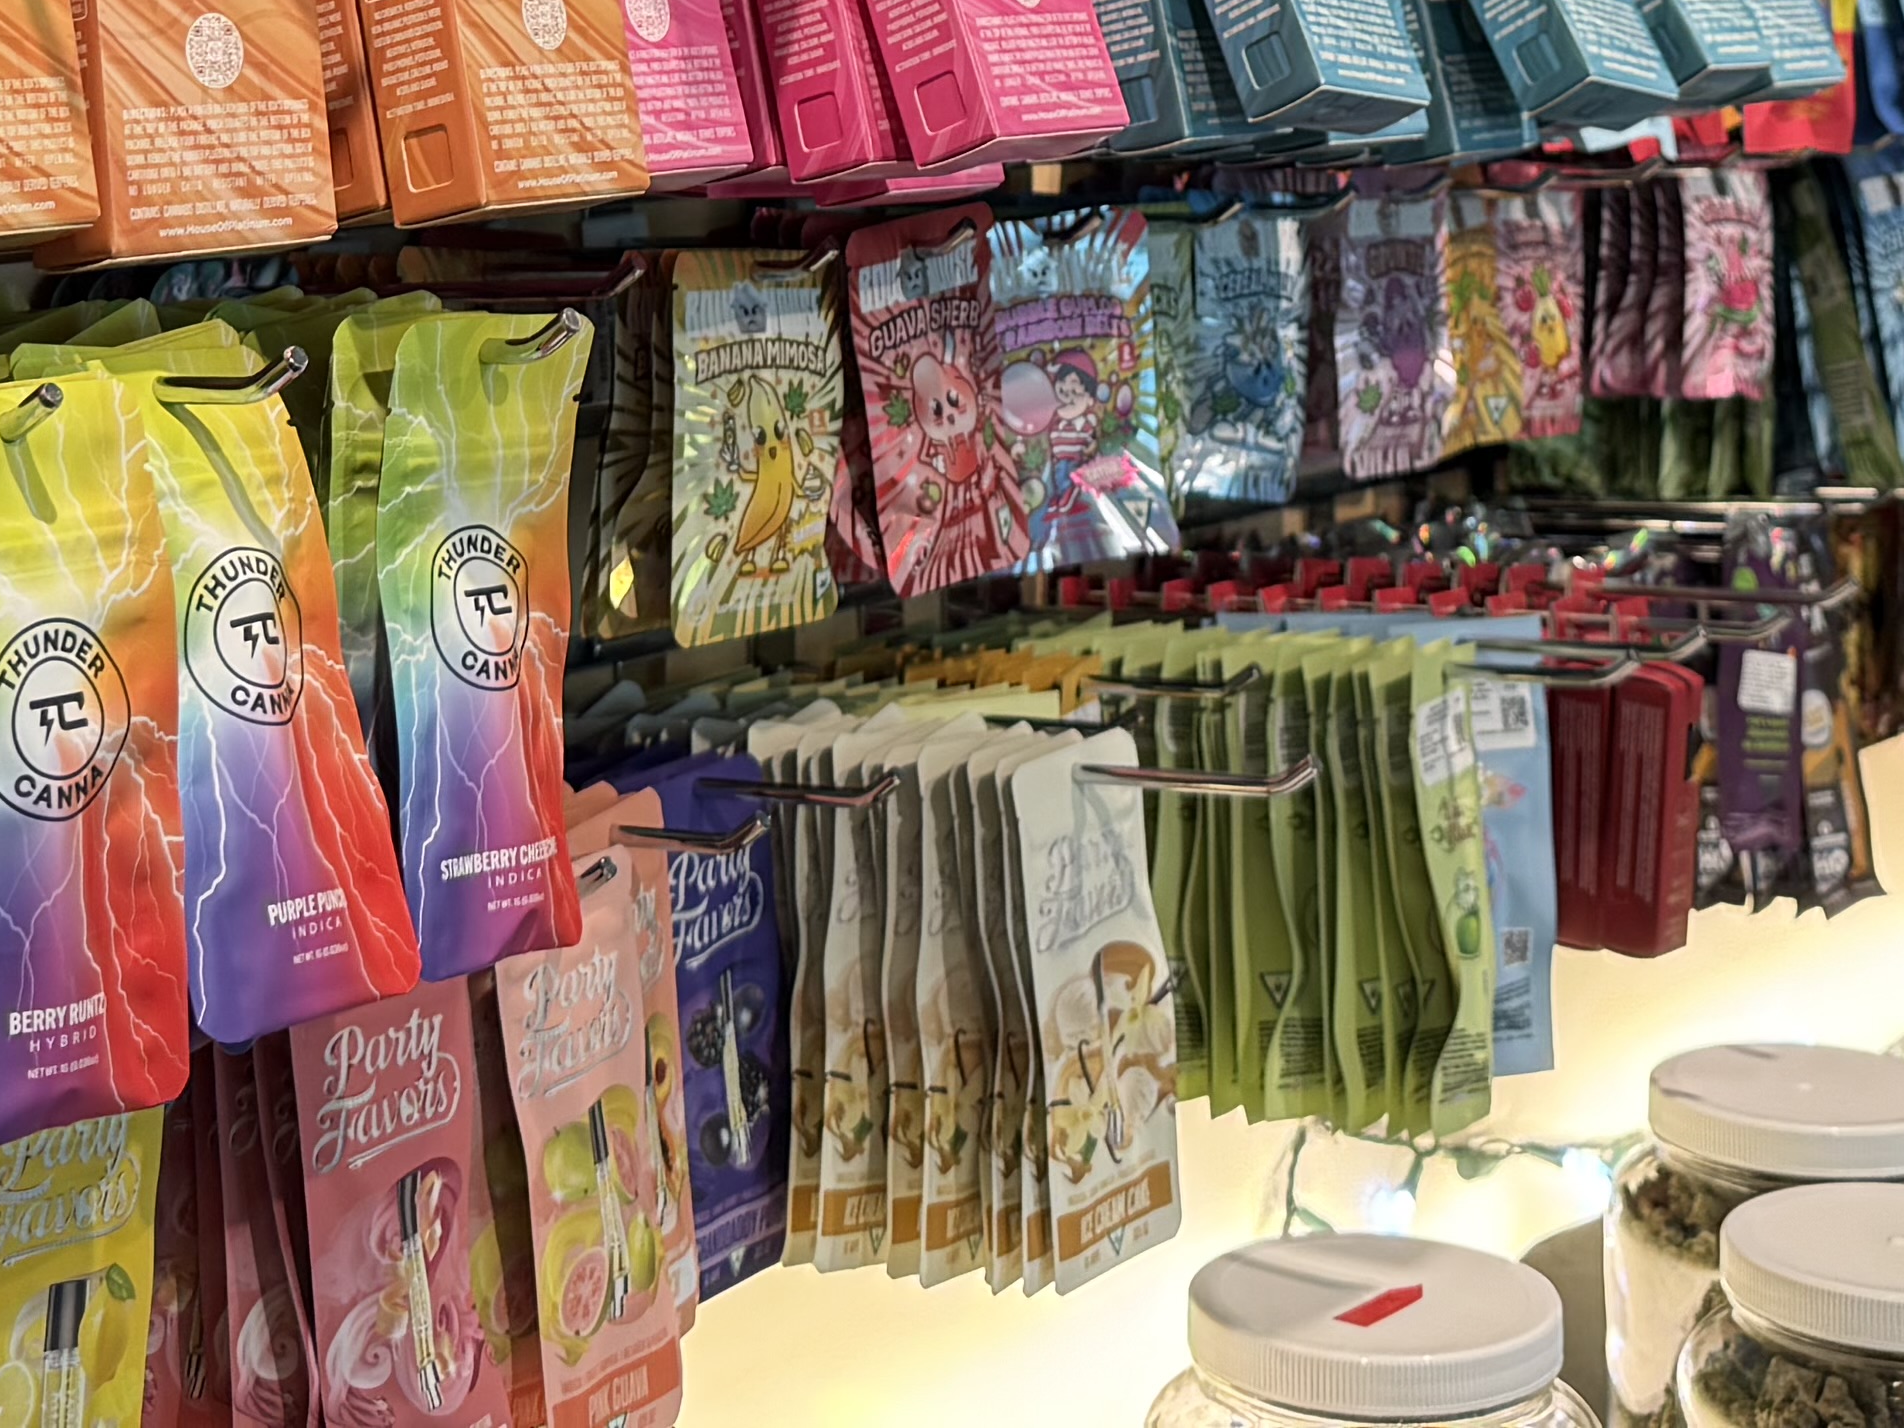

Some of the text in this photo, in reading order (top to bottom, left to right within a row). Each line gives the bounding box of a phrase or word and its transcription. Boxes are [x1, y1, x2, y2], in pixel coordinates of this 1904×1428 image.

[870, 308, 927, 356] GUAVA
[696, 339, 827, 376] BANANA MIMOSA
[437, 535, 522, 582] THUNDER
[195, 555, 290, 614] THUNDER
[230, 682, 297, 716] CANNA
[13, 764, 105, 811] CANNA
[440, 850, 518, 881] STRAWBERRY
[486, 868, 543, 888] INDICA
[267, 894, 314, 927] PURPLE
[293, 915, 343, 939] INDICA
[8, 1006, 67, 1037] BERRY
[29, 1025, 98, 1053] HYBRID
[324, 1007, 444, 1100] Party
[312, 1074, 450, 1174] Favors
